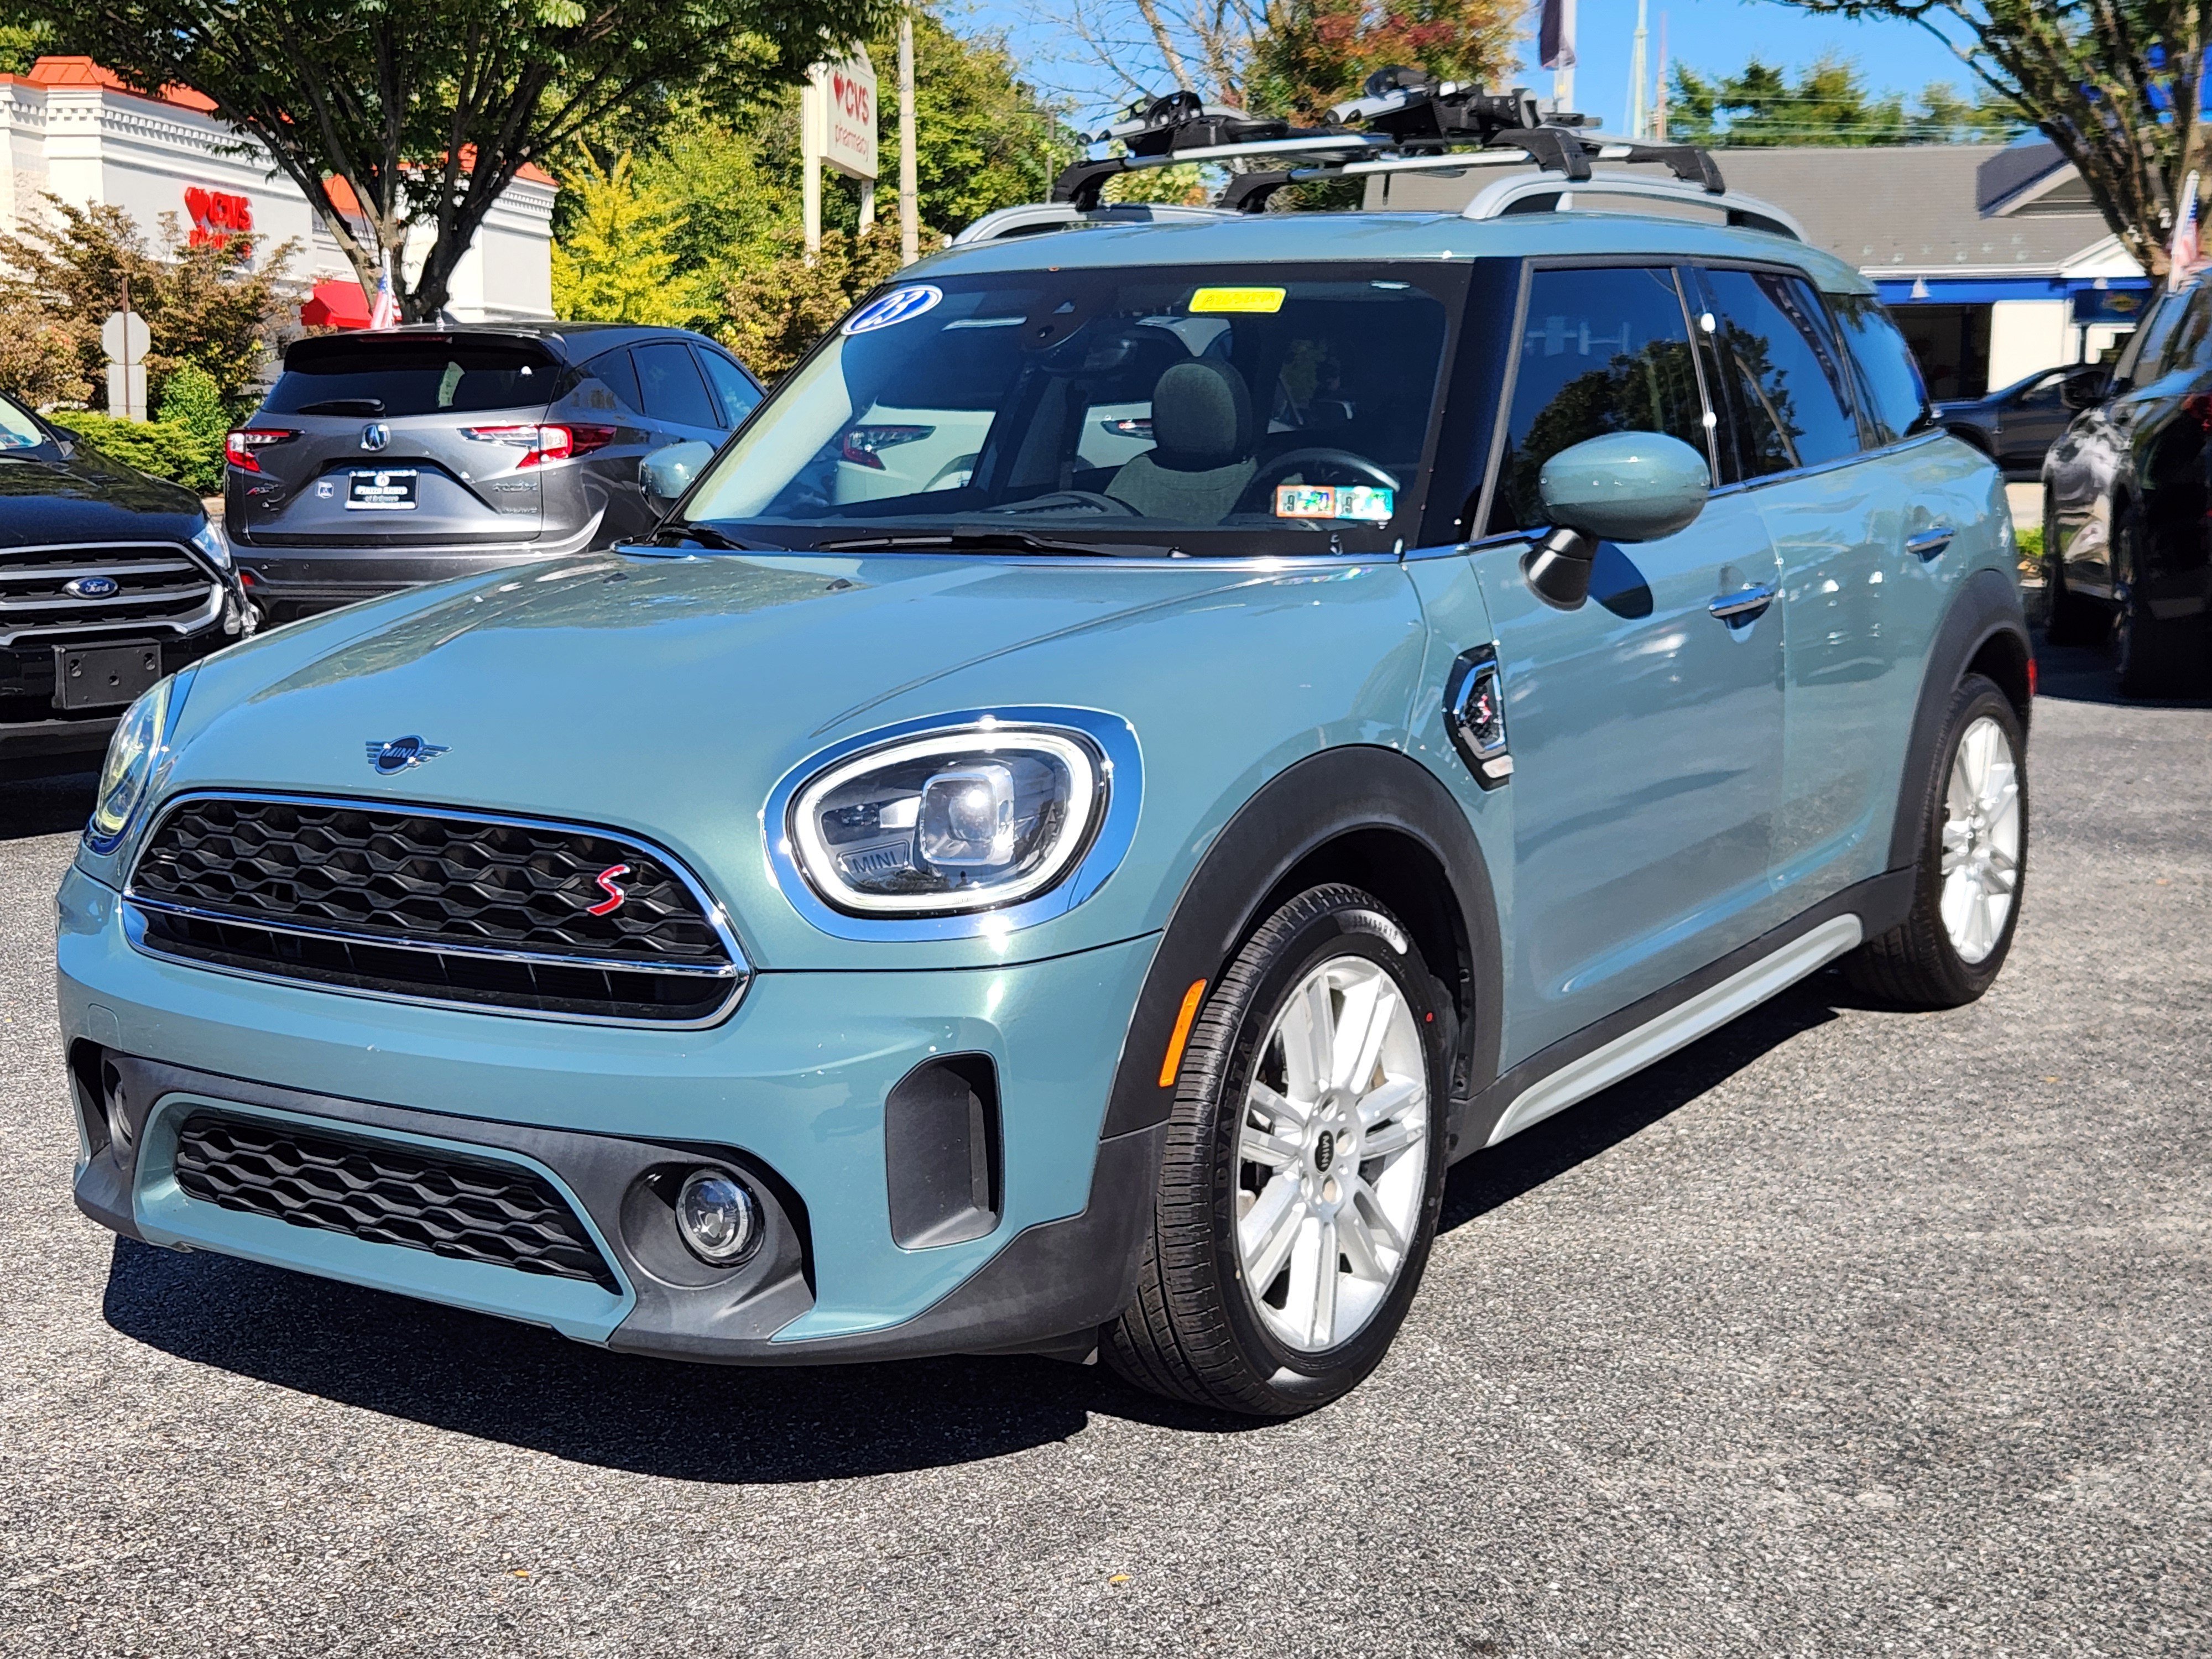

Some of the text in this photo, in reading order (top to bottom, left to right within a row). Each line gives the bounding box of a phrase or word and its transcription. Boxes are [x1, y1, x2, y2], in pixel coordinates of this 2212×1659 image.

[846, 78, 869, 127] CVS
[835, 121, 869, 163] pharmacy
[208, 191, 252, 231] CVS
[85, 581, 109, 593] Ford
[382, 747, 416, 758] MINI
[852, 851, 897, 873] MINI
[586, 864, 630, 916] S
[1321, 1135, 1330, 1168] MINI
